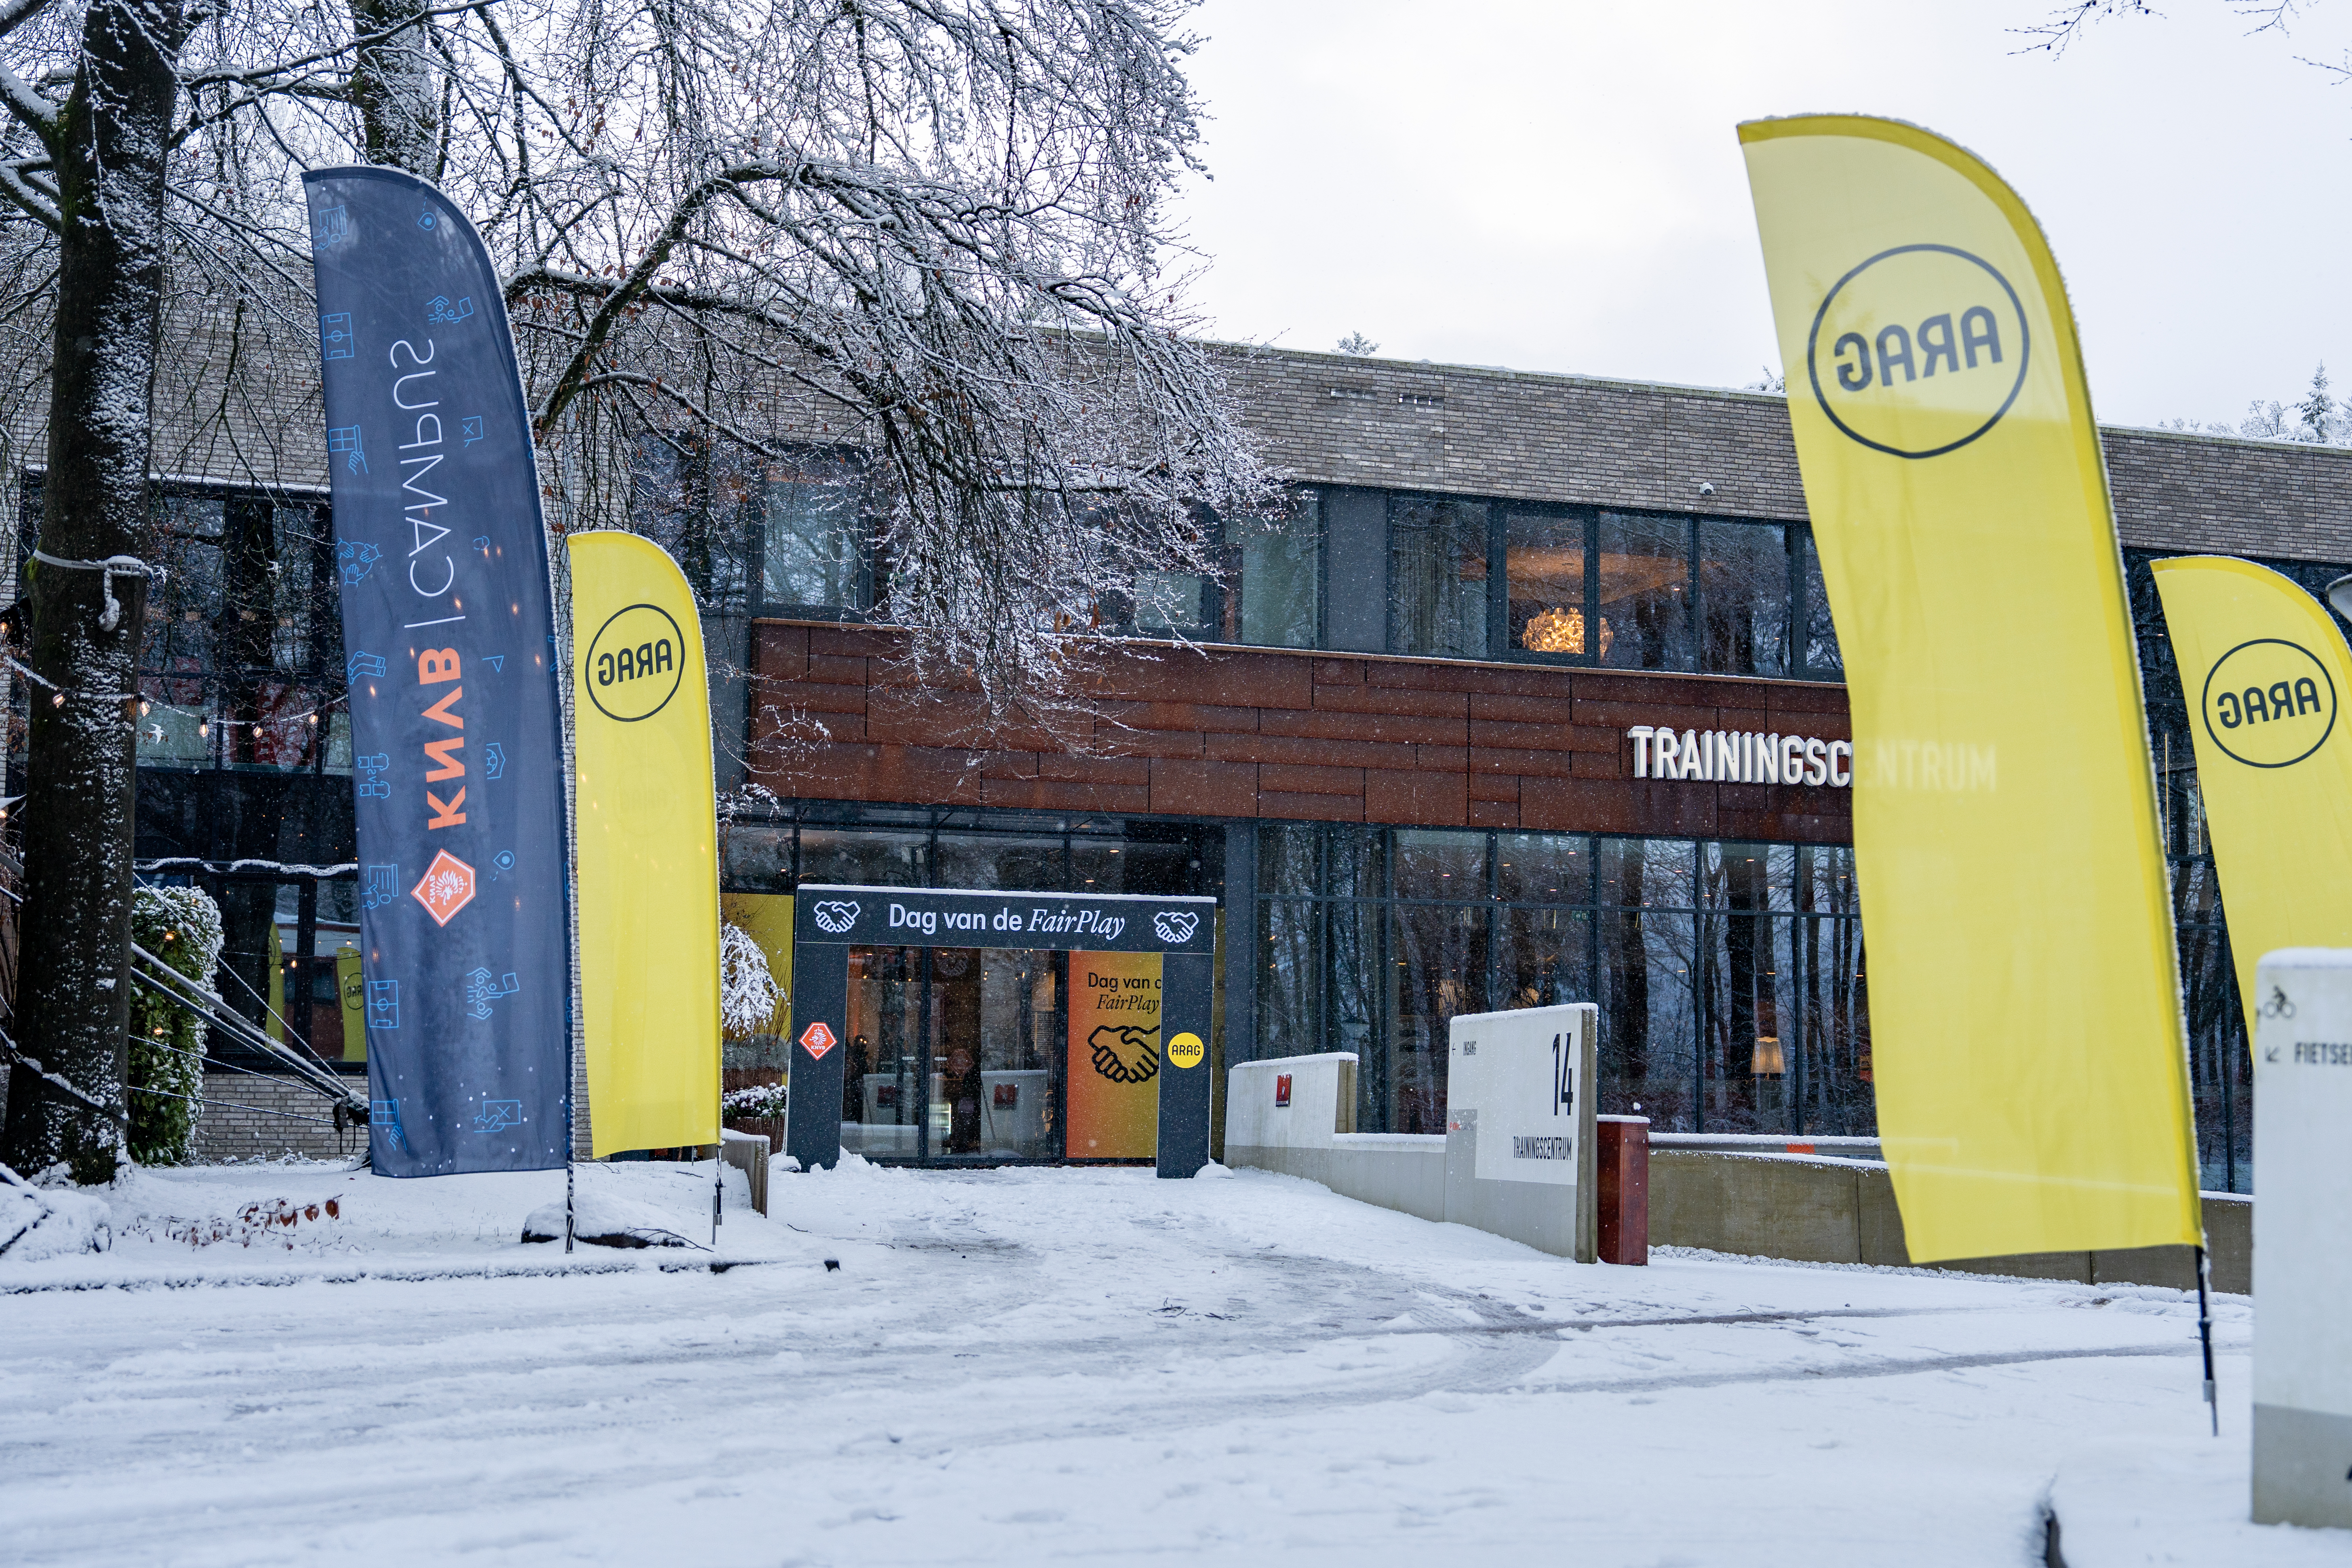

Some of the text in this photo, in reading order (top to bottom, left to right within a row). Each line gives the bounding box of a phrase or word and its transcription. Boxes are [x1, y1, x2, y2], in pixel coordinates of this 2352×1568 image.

[889, 904, 1125, 940] Dag van de FairPlay
[1088, 972, 1118, 993] Dag
[1123, 978, 1150, 989] van
[1096, 994, 1159, 1014] FairPlay
[1172, 1045, 1200, 1056] ARAG
[1463, 1041, 1476, 1056] INGANG
[2295, 1042, 2352, 1064] FIETSE
[1553, 1033, 1573, 1116] 14
[1513, 1136, 1572, 1161] TRAININGSCENTRUM
